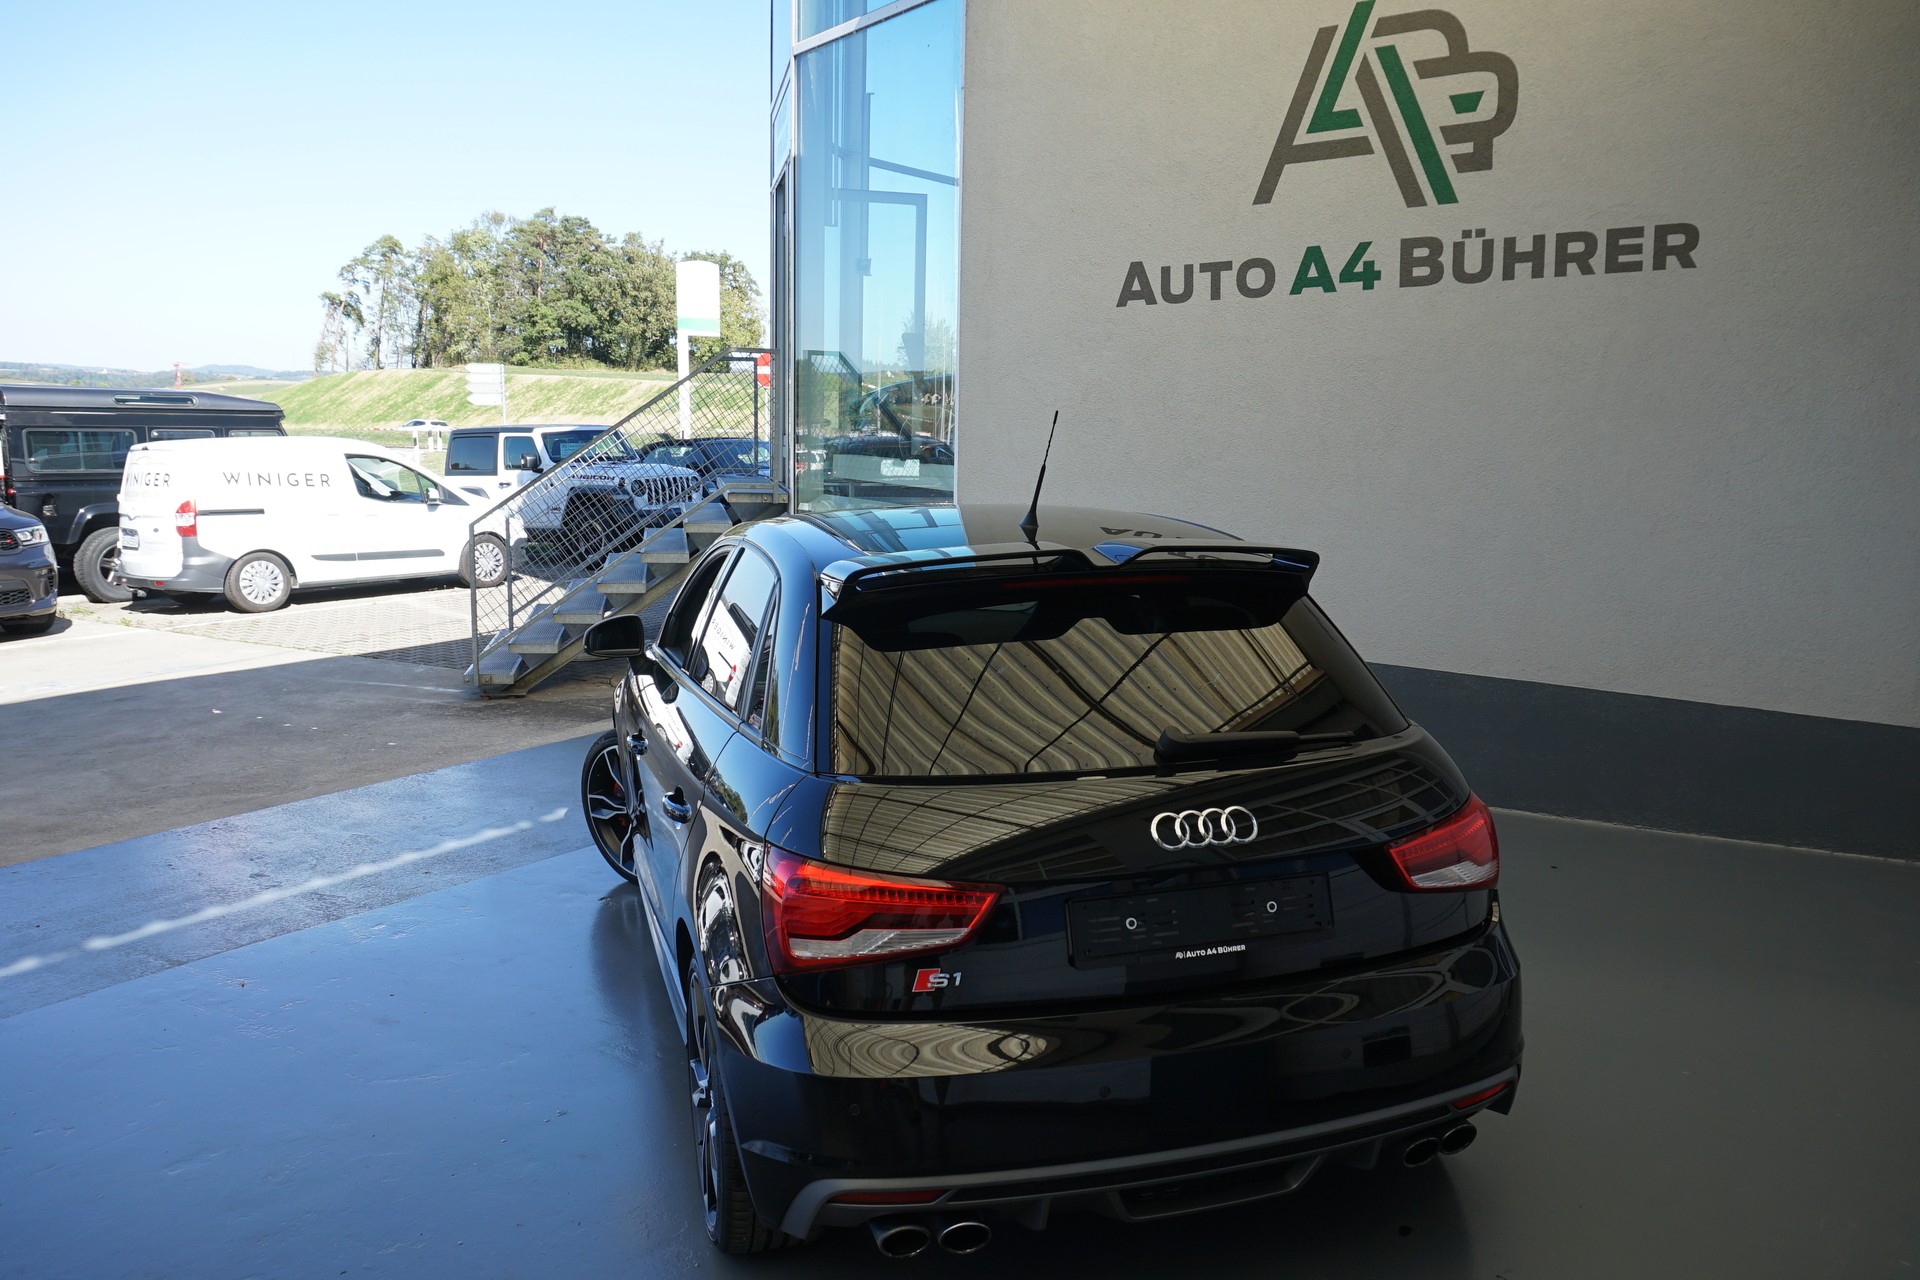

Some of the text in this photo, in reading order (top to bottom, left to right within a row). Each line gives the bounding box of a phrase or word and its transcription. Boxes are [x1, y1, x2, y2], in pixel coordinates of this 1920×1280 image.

[1116, 222, 1700, 307] AUTO A4 BÜHRER
[222, 472, 331, 487] WINIGER
[1186, 949, 1206, 958] AUTO
[1207, 947, 1217, 955] A4
[927, 972, 962, 988] S1
